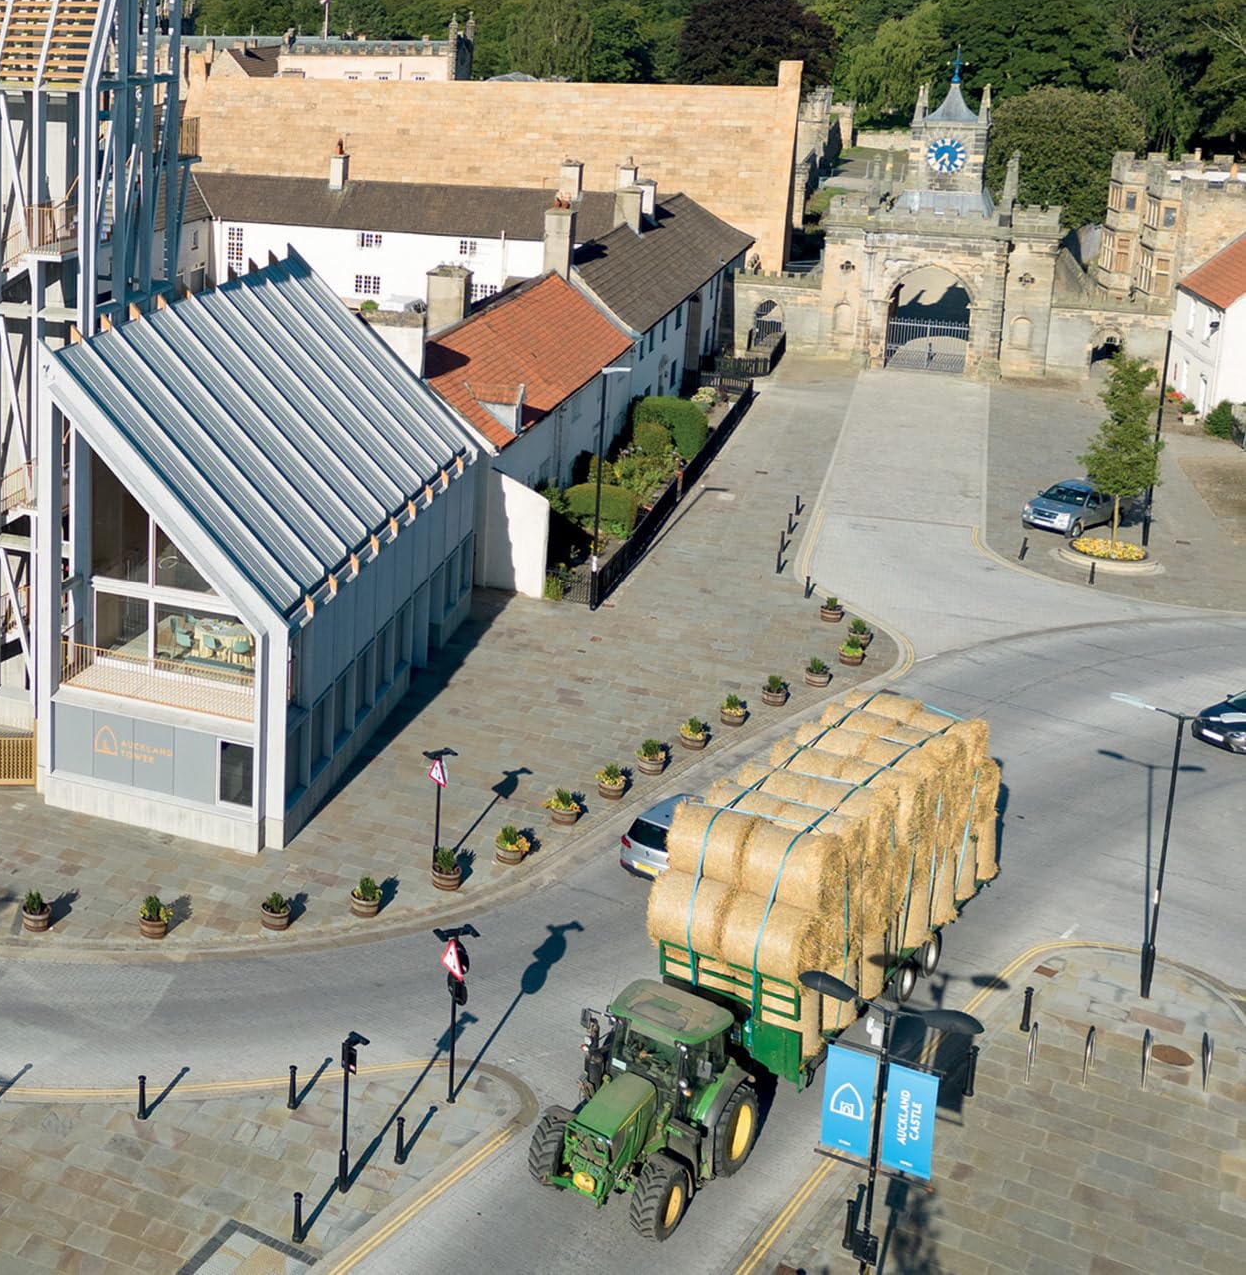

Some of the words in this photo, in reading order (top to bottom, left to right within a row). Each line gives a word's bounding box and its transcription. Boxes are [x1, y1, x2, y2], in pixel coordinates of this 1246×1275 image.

[121, 740, 173, 757] AUCKLAND
[121, 750, 155, 764] TOWER
[896, 1089, 911, 1146] AUCKLAND
[908, 1101, 922, 1141] CASTLE
